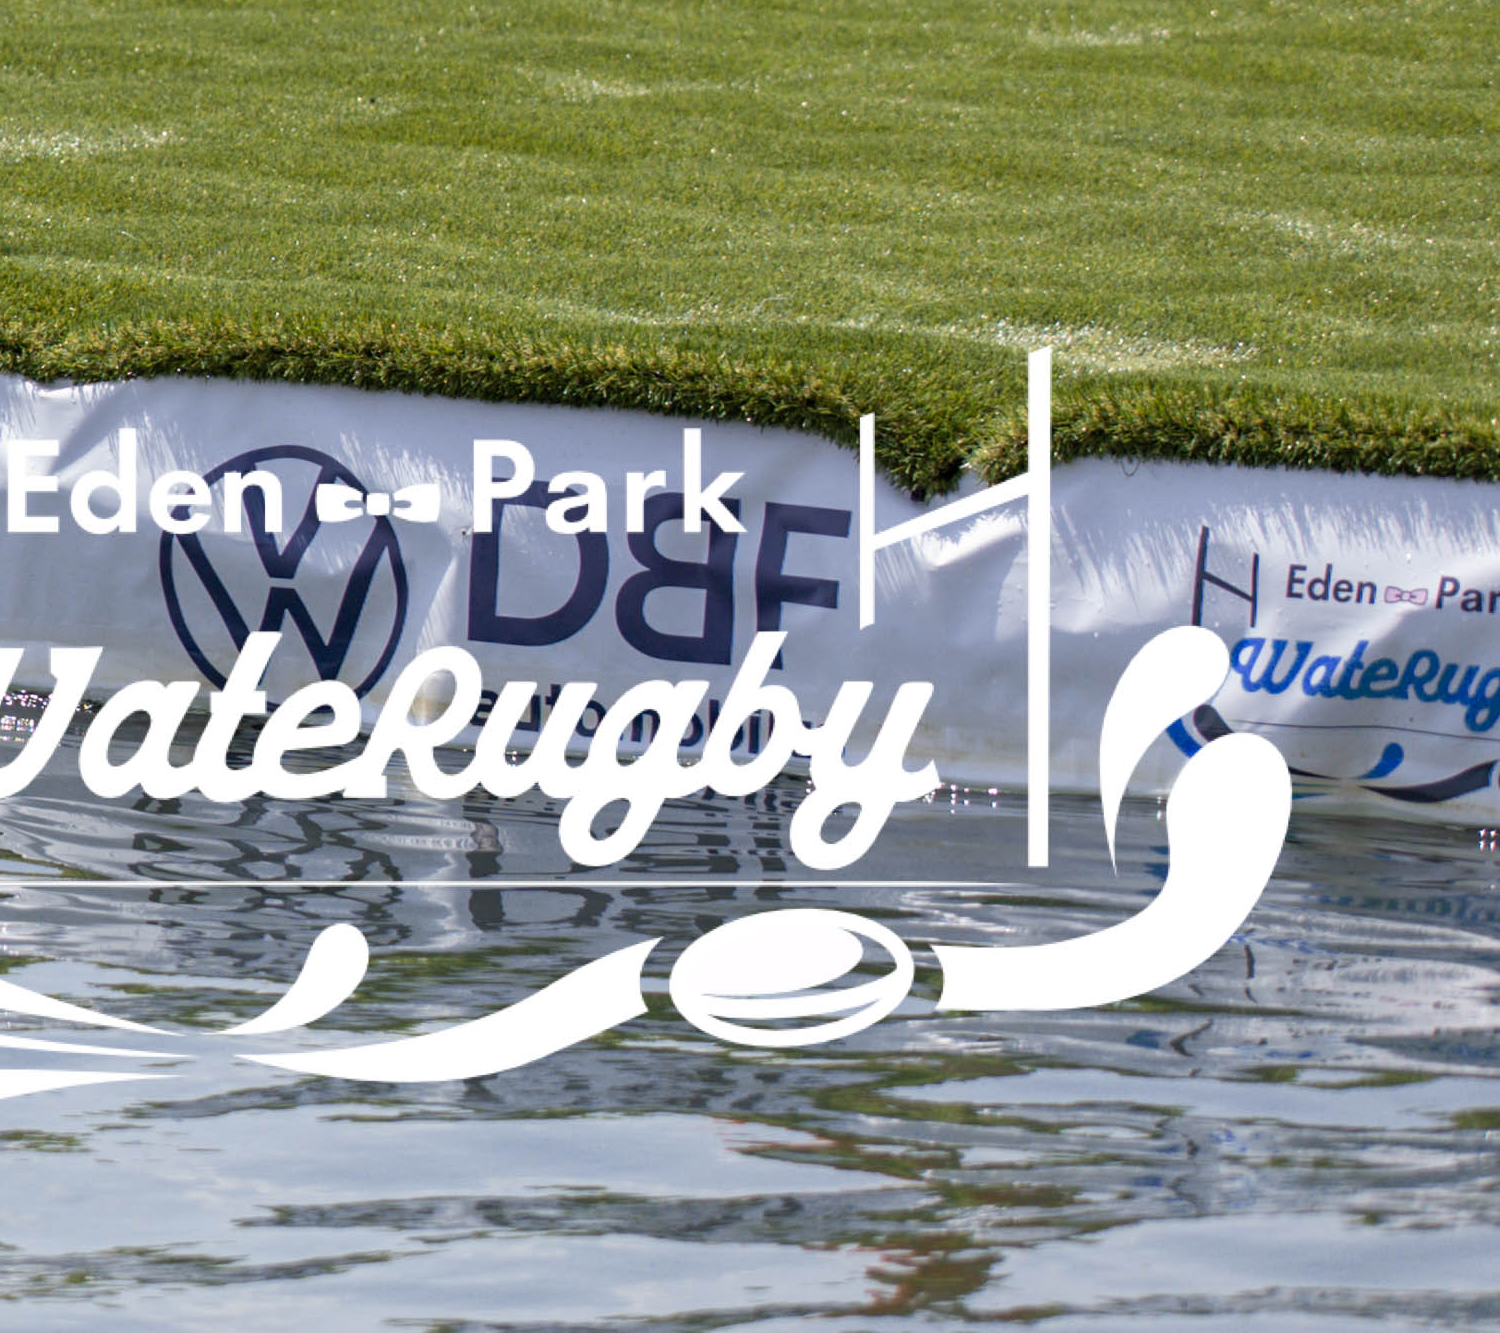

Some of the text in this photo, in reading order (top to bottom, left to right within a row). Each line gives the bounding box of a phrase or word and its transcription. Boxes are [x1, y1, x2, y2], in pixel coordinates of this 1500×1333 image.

[1285, 562, 1500, 615] Eden Par
[1229, 636, 1500, 733] WateRug
